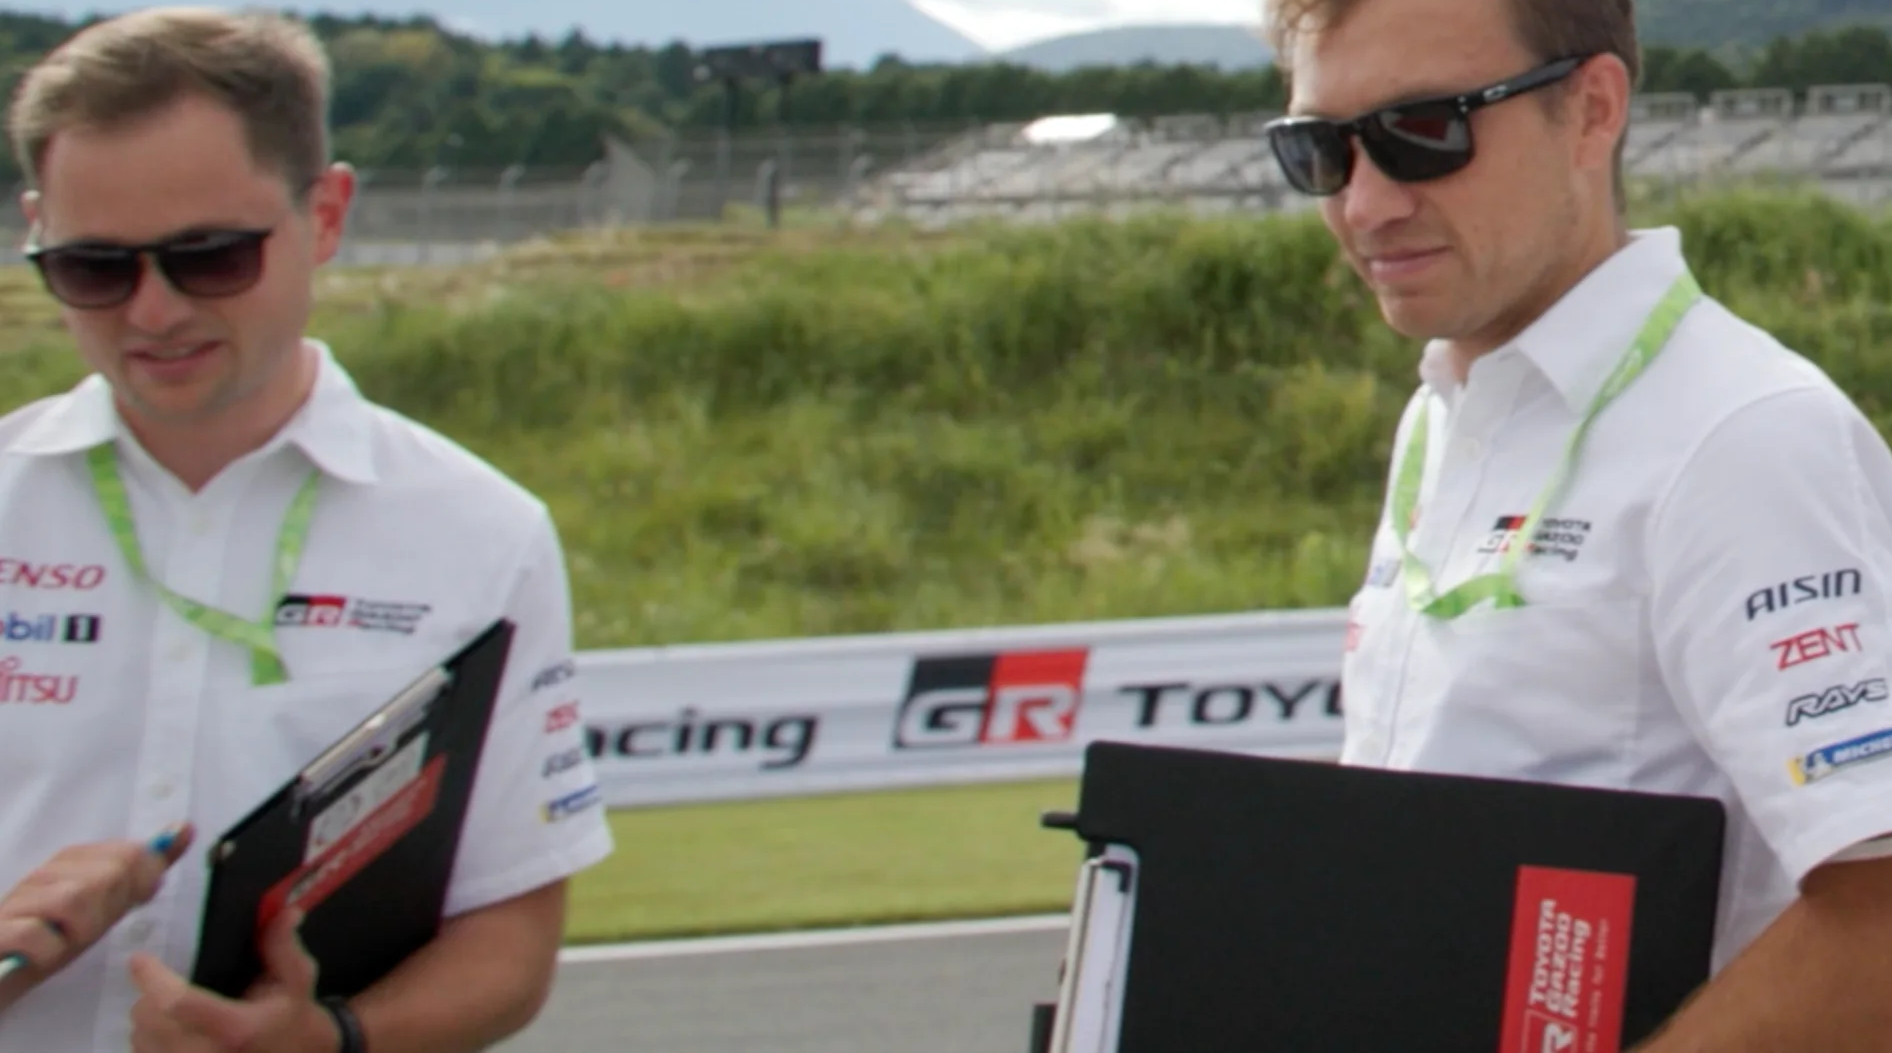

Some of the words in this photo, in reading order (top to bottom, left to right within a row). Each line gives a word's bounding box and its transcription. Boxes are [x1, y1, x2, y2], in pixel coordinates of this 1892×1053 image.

[1745, 568, 1862, 621] AISIN
[0, 612, 57, 641] bil
[1769, 622, 1863, 671] ZENT
[1784, 678, 1890, 727] RAYS
[1528, 899, 1557, 1005] TOYOTA
[1546, 911, 1572, 1013] GAZOO
[1560, 918, 1592, 1018] Racing
